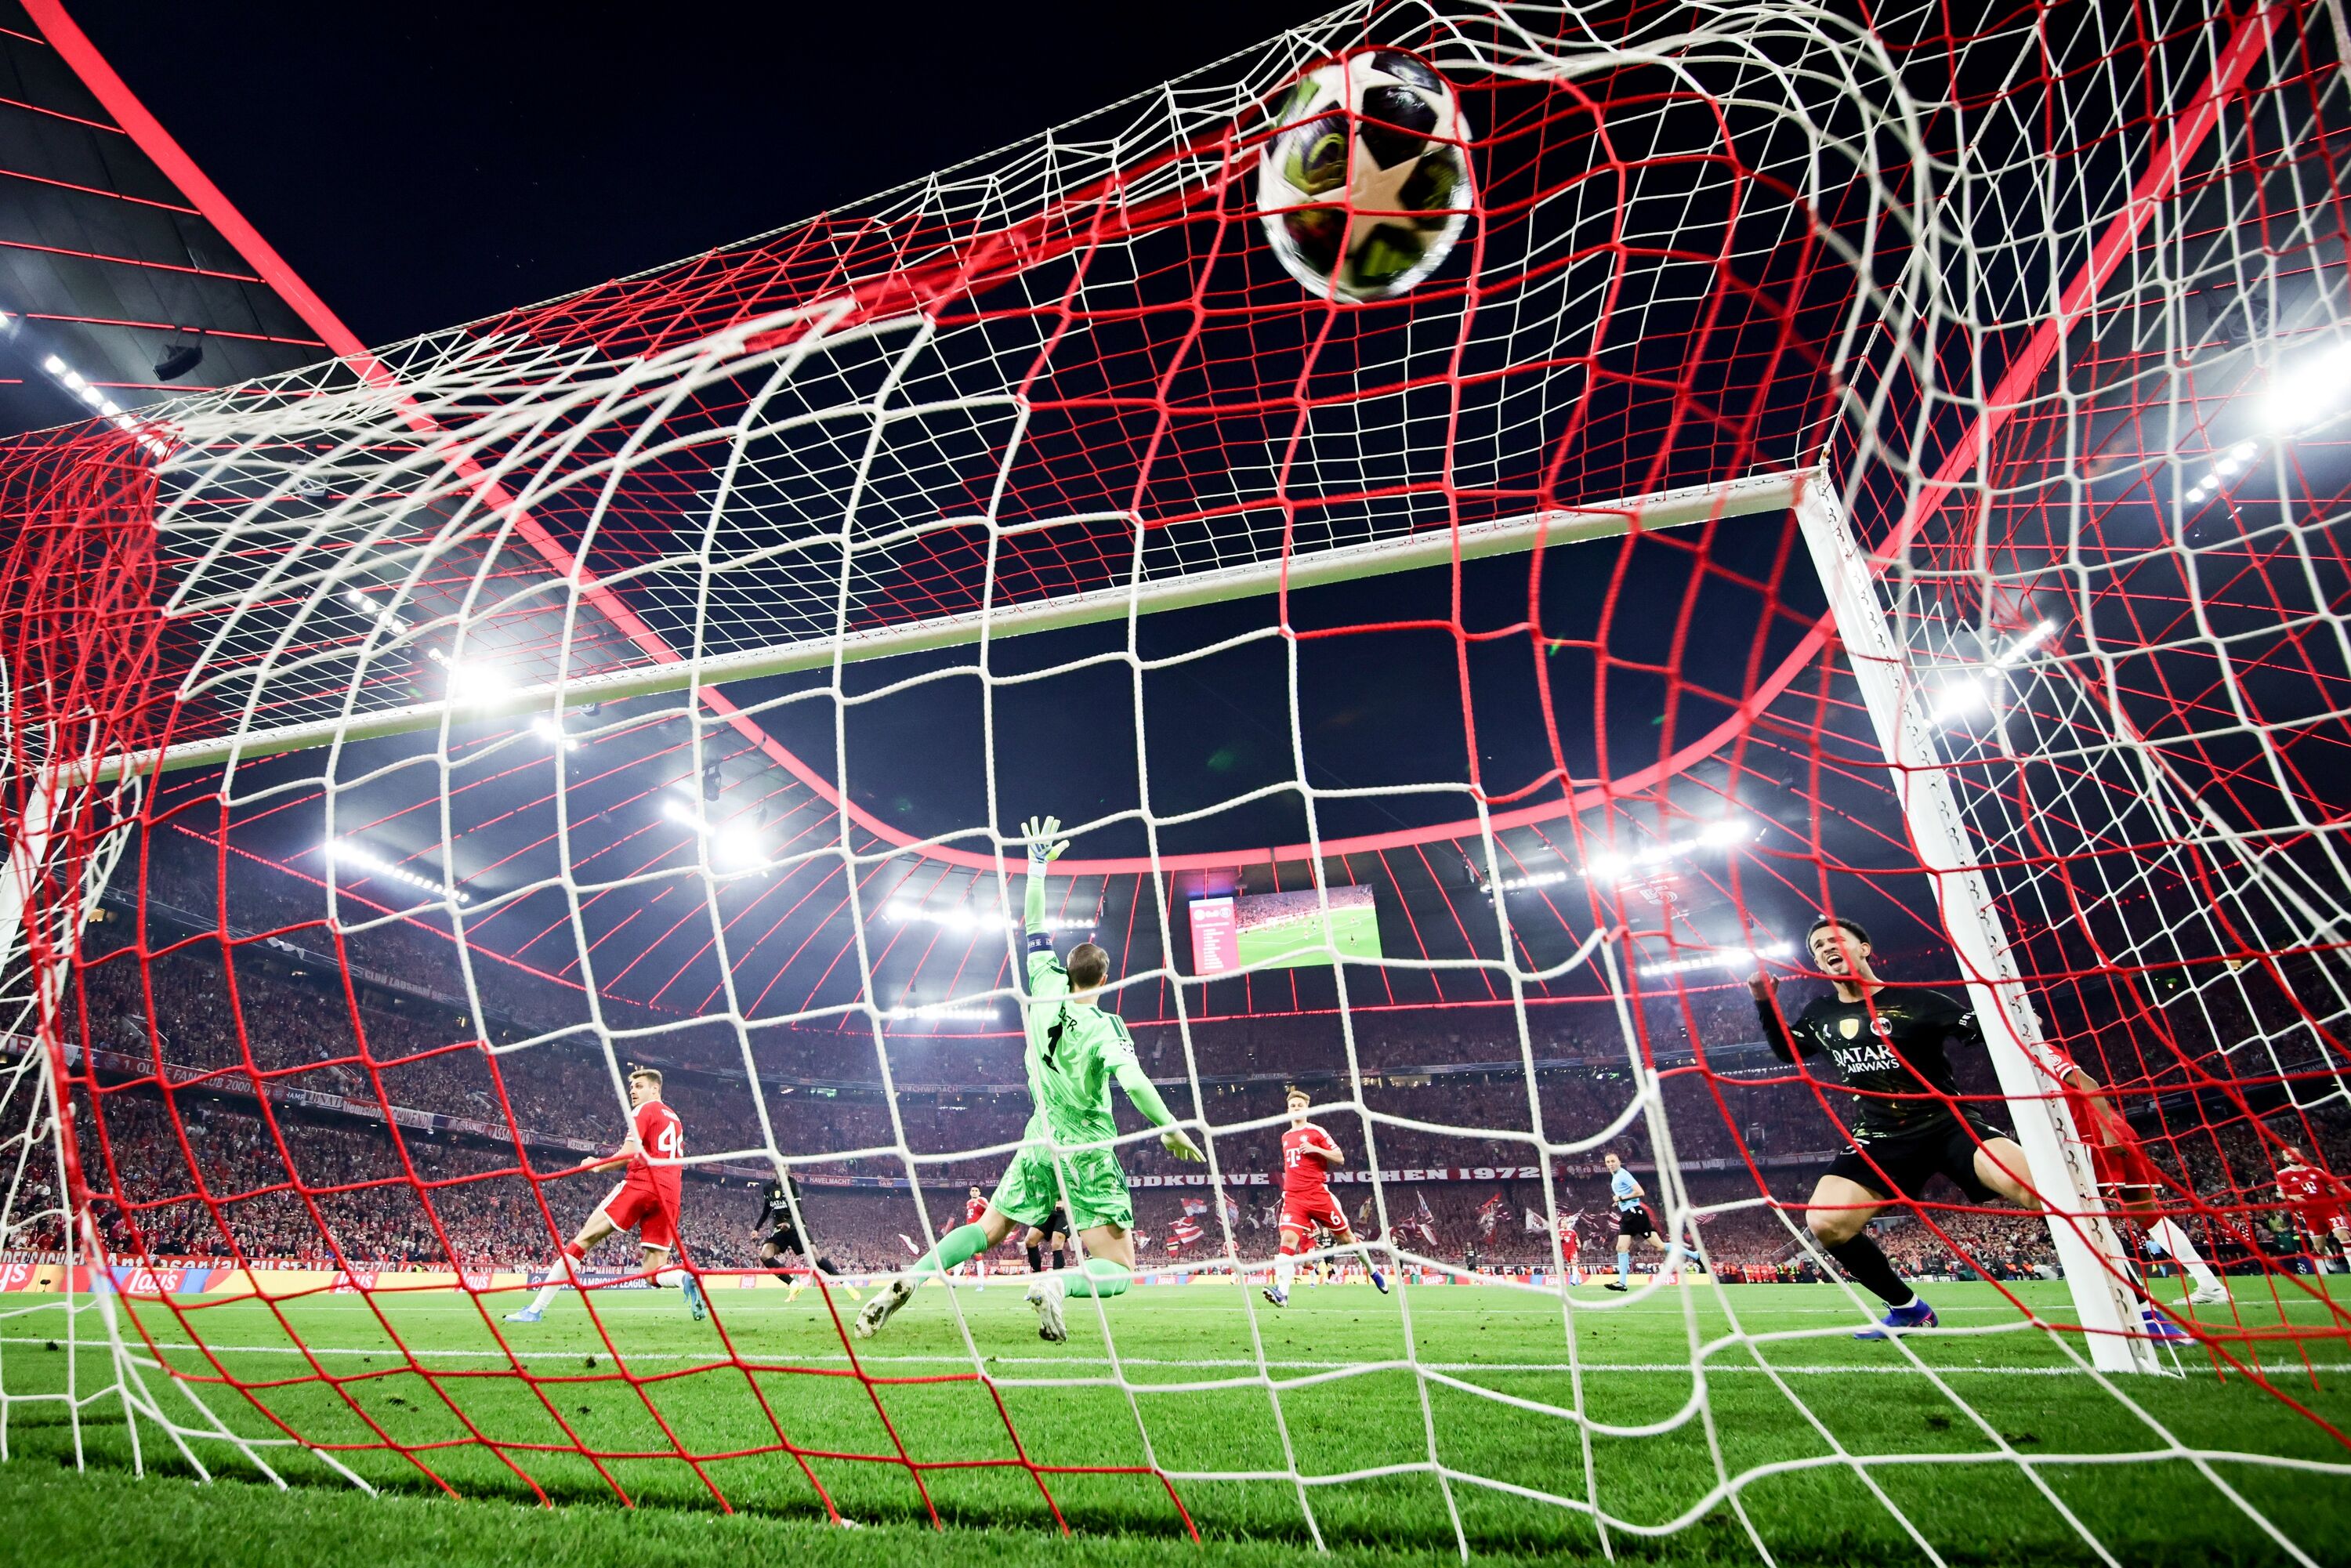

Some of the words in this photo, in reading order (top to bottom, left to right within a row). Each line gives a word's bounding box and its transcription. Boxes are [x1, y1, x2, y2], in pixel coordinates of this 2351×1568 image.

[1831, 1045, 1896, 1067] QATAR
[1847, 1058, 1900, 1074] AIRWAYS
[2302, 1060, 2343, 1074] CHAMPINS
[226, 1078, 251, 1092] 2000
[810, 1176, 851, 1186] HAVELMACHT
[1125, 1173, 1270, 1188] ÜDKURVE
[1459, 1166, 1541, 1180] 1972
[1331, 1211, 1342, 1226] 6
[127, 1268, 177, 1293] Lay's
[620, 1277, 647, 1289] LEAGUE
